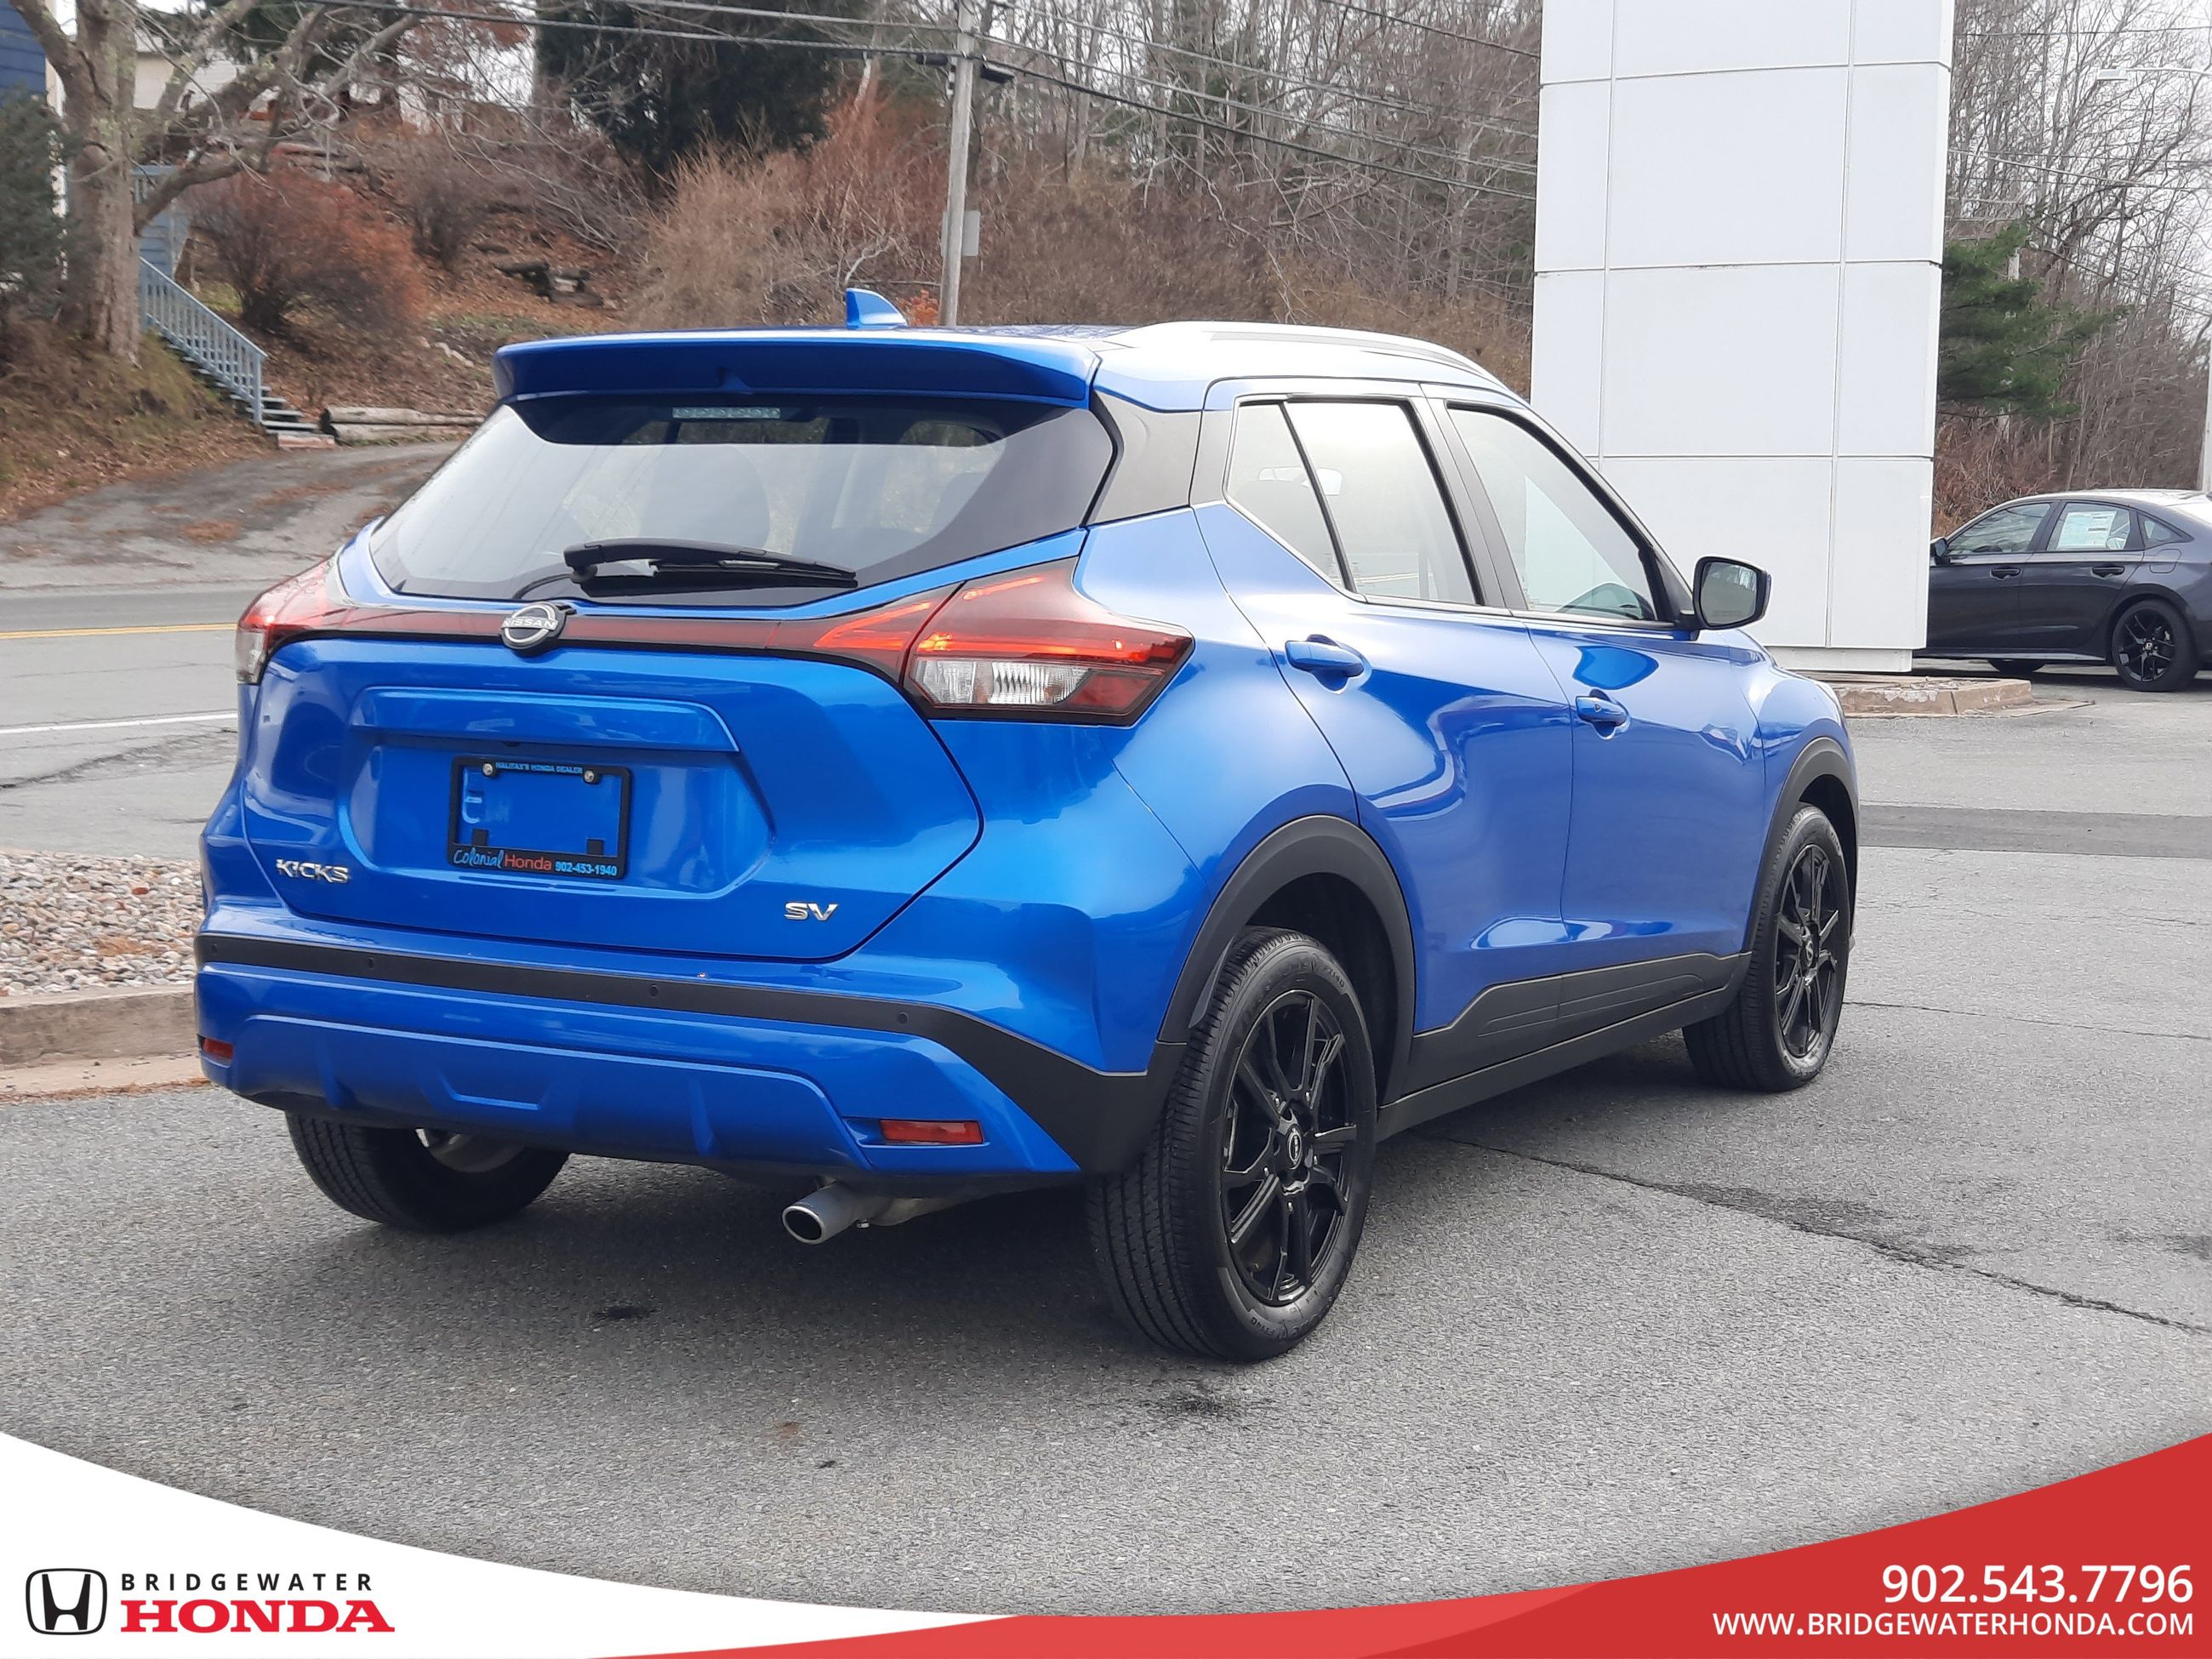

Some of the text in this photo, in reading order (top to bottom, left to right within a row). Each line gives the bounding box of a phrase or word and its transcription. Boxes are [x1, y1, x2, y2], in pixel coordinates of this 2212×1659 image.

[502, 619, 558, 630] NISSAN
[531, 764, 556, 772] HONDA
[276, 858, 350, 884] KICKS
[453, 847, 618, 877] Colonial Honda 902-453-1940
[784, 902, 840, 921] SV
